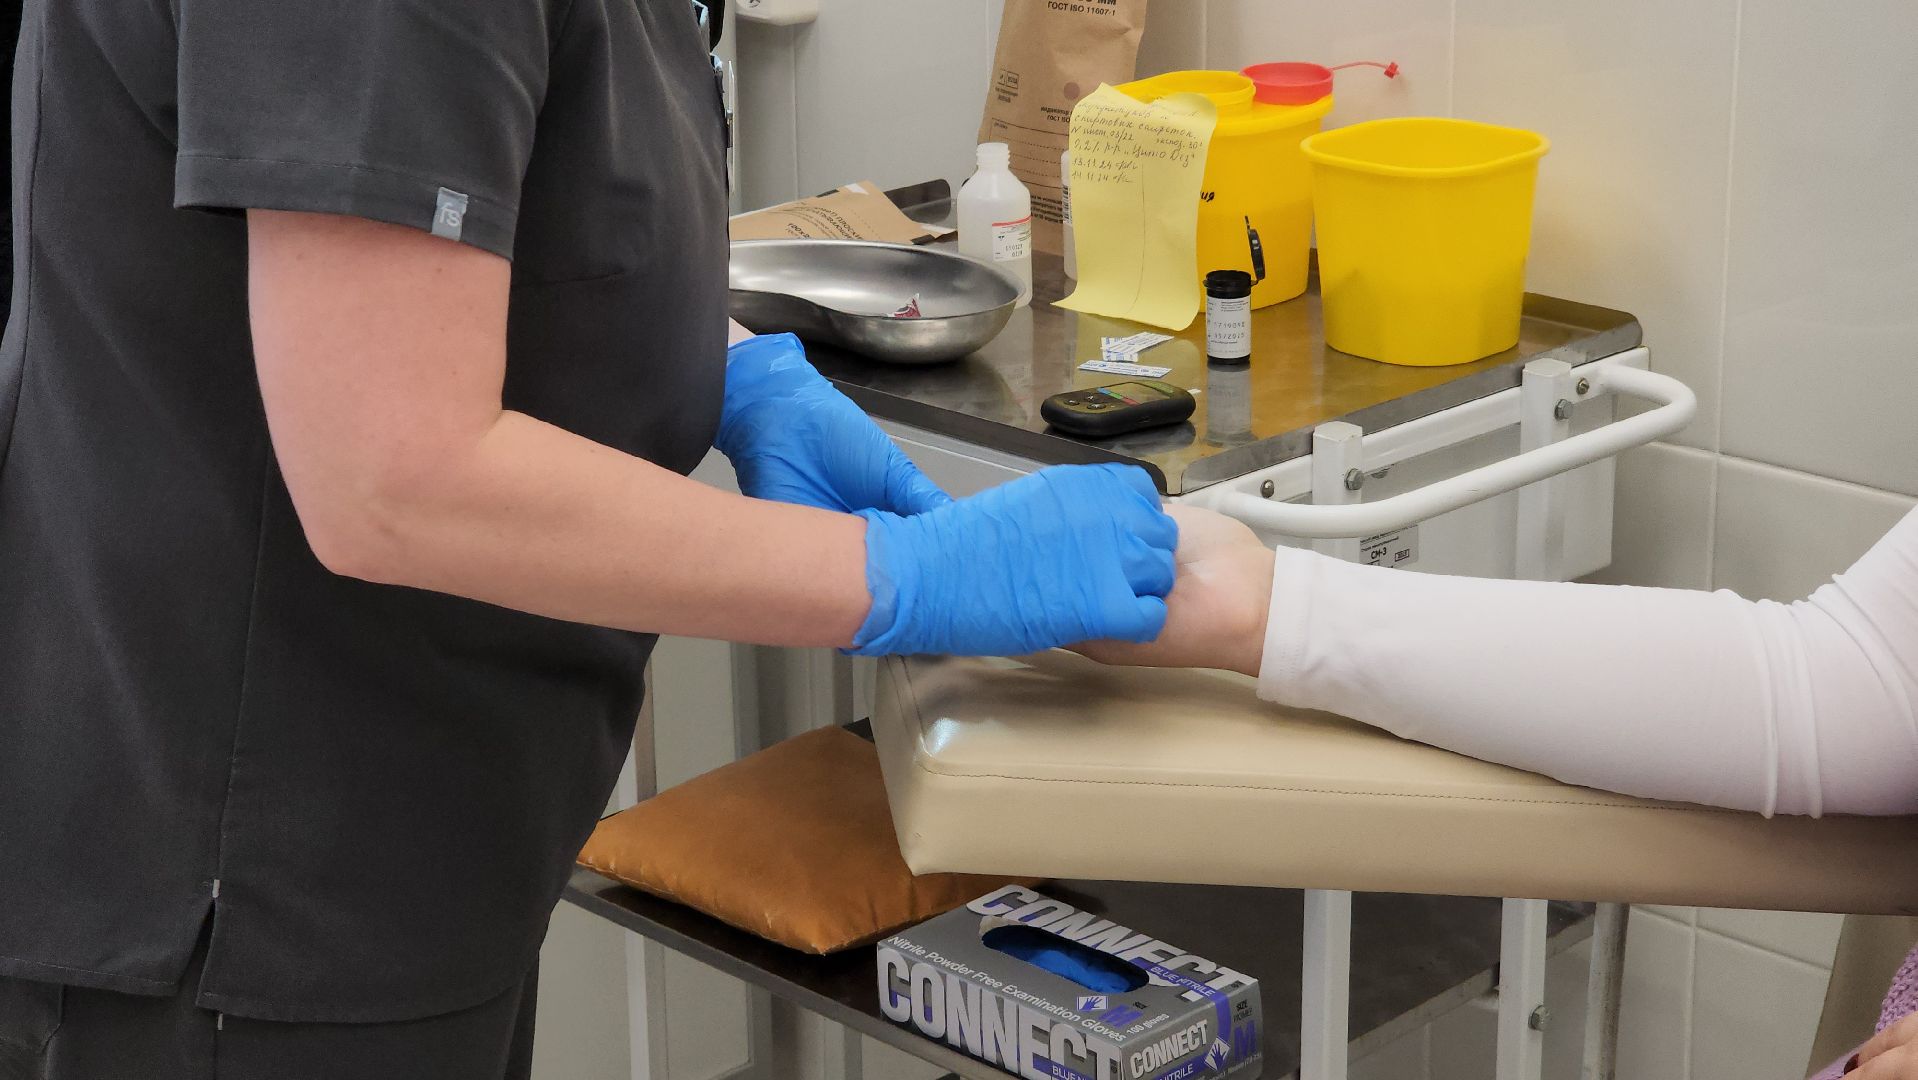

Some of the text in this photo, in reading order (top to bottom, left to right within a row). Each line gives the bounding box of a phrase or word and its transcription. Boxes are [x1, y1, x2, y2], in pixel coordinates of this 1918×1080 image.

[1047, 1, 1068, 11] ГОСТ
[1070, 4, 1085, 13] ISO
[966, 884, 1259, 1002] CONNECT
[887, 936, 1127, 1043] Nitrile Powder Free Examination Gloves
[1150, 966, 1215, 998] BLUE NITRILE
[877, 946, 1121, 1080] CONNECT
[1126, 1024, 1144, 1036] 100
[1129, 1019, 1208, 1080] CONNECT
